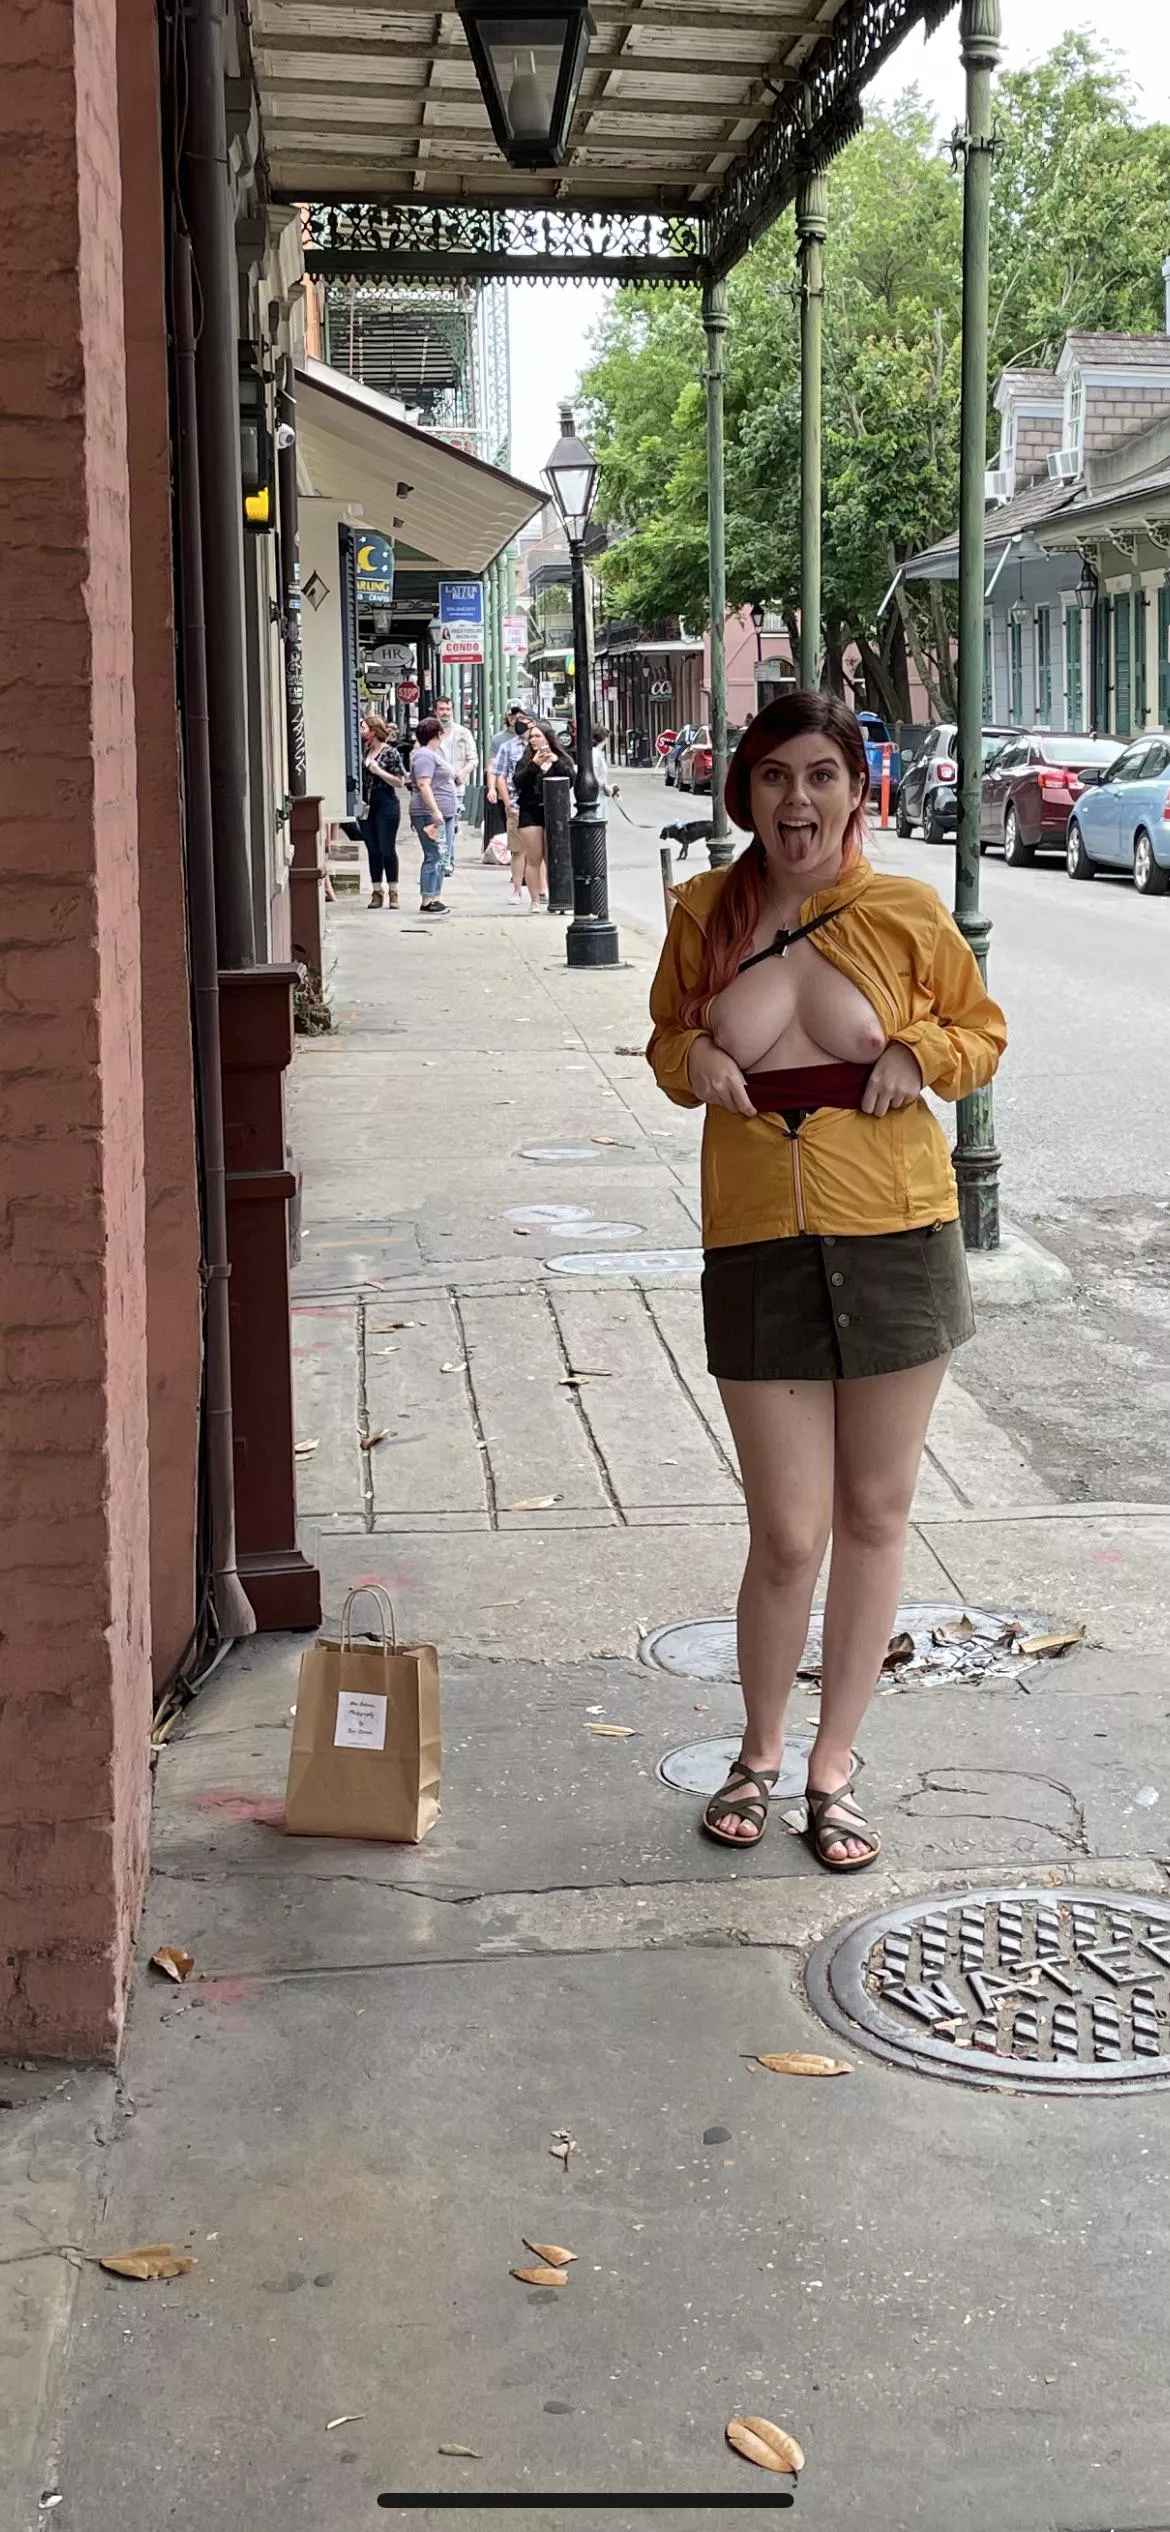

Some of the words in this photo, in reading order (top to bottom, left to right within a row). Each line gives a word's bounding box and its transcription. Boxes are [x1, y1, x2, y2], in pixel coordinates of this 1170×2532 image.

[356, 580, 390, 592] ARLING
[445, 585, 478, 593] LATTER
[446, 643, 479, 652] CONDO
[382, 649, 405, 660] HR
[398, 688, 418, 698] STOP
